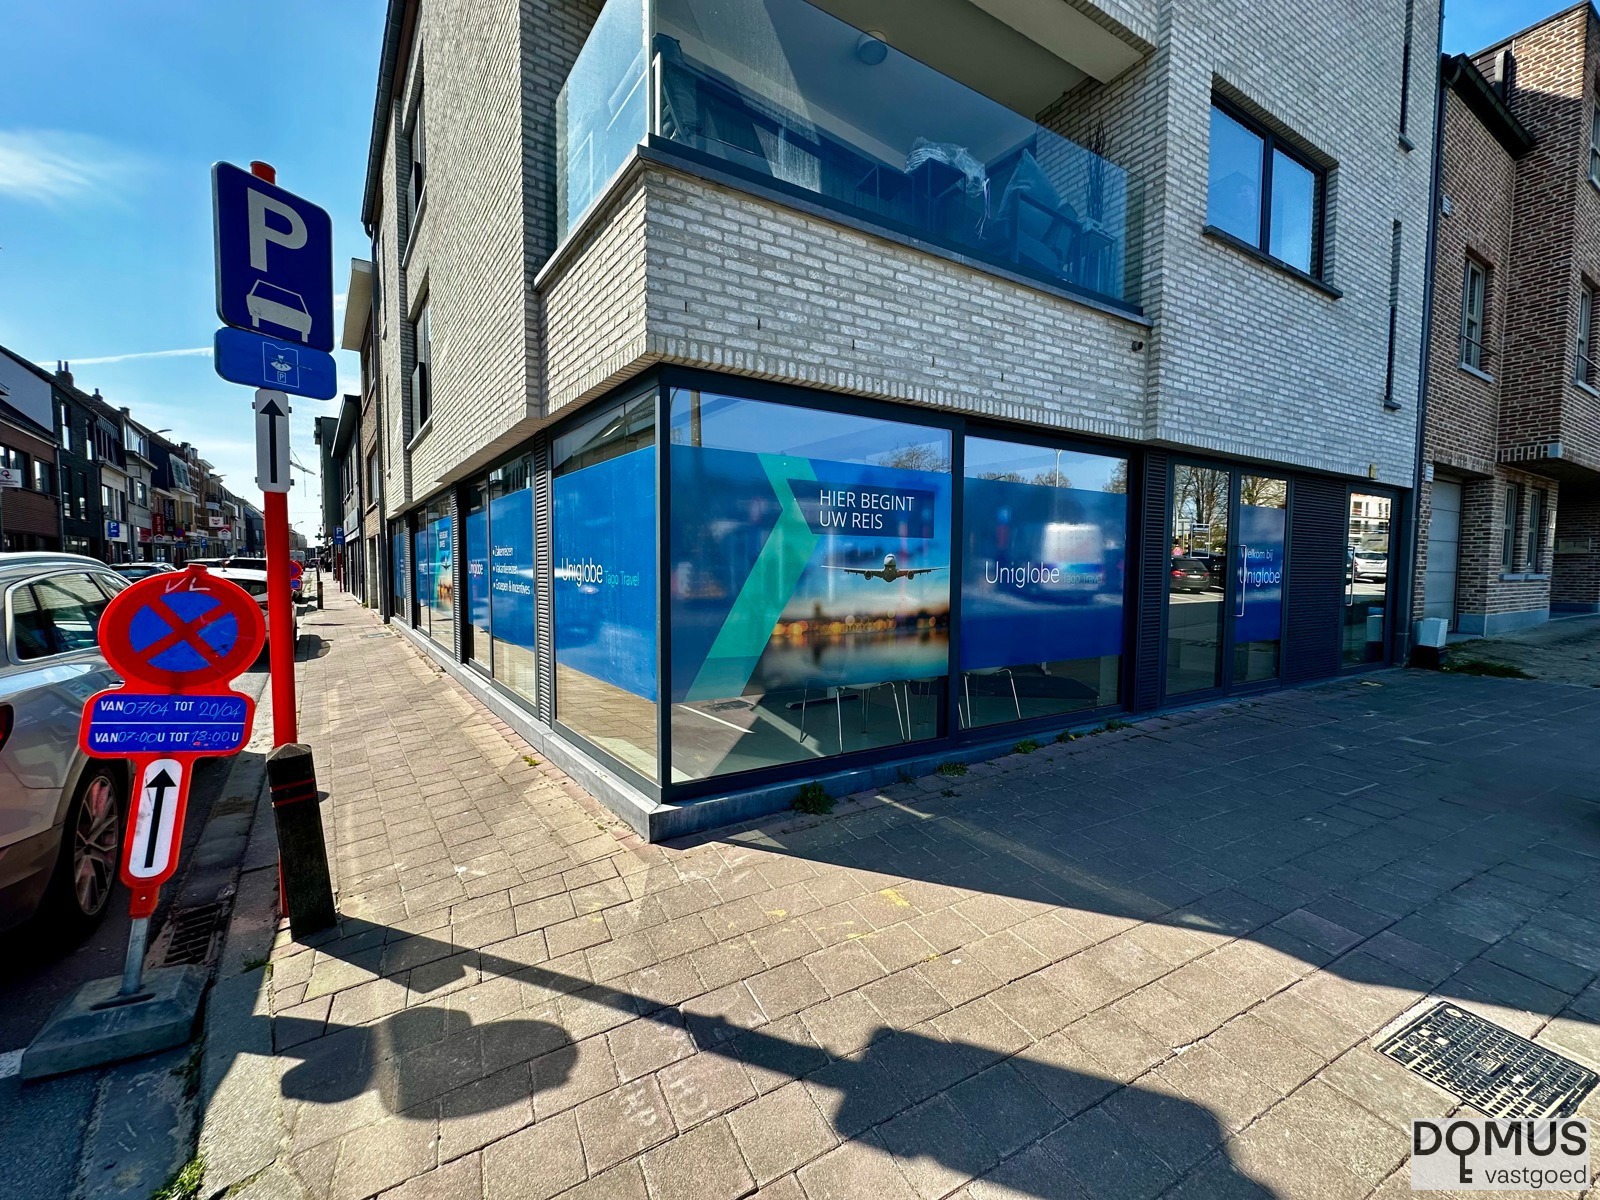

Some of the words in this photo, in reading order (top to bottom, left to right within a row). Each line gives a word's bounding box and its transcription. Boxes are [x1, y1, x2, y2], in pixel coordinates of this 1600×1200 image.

[247, 187, 308, 272] P
[820, 489, 856, 508] HIER
[861, 492, 915, 511] BEGINT
[820, 510, 847, 528] UW
[852, 512, 883, 529] REIS
[336, 527, 342, 535] P
[561, 557, 603, 587] Uniglobe
[604, 570, 619, 588] Tago
[620, 570, 640, 587] Travel
[985, 560, 1060, 588] Uniglobe
[1063, 573, 1080, 585] Tago
[1240, 567, 1280, 588] Uniglobe
[100, 701, 124, 711] VAN
[123, 702, 170, 717] 07/04
[175, 701, 194, 712] TOT
[199, 702, 241, 720] 20/04
[95, 732, 118, 743] VAN
[169, 732, 189, 742] TOT
[231, 732, 239, 742] U
